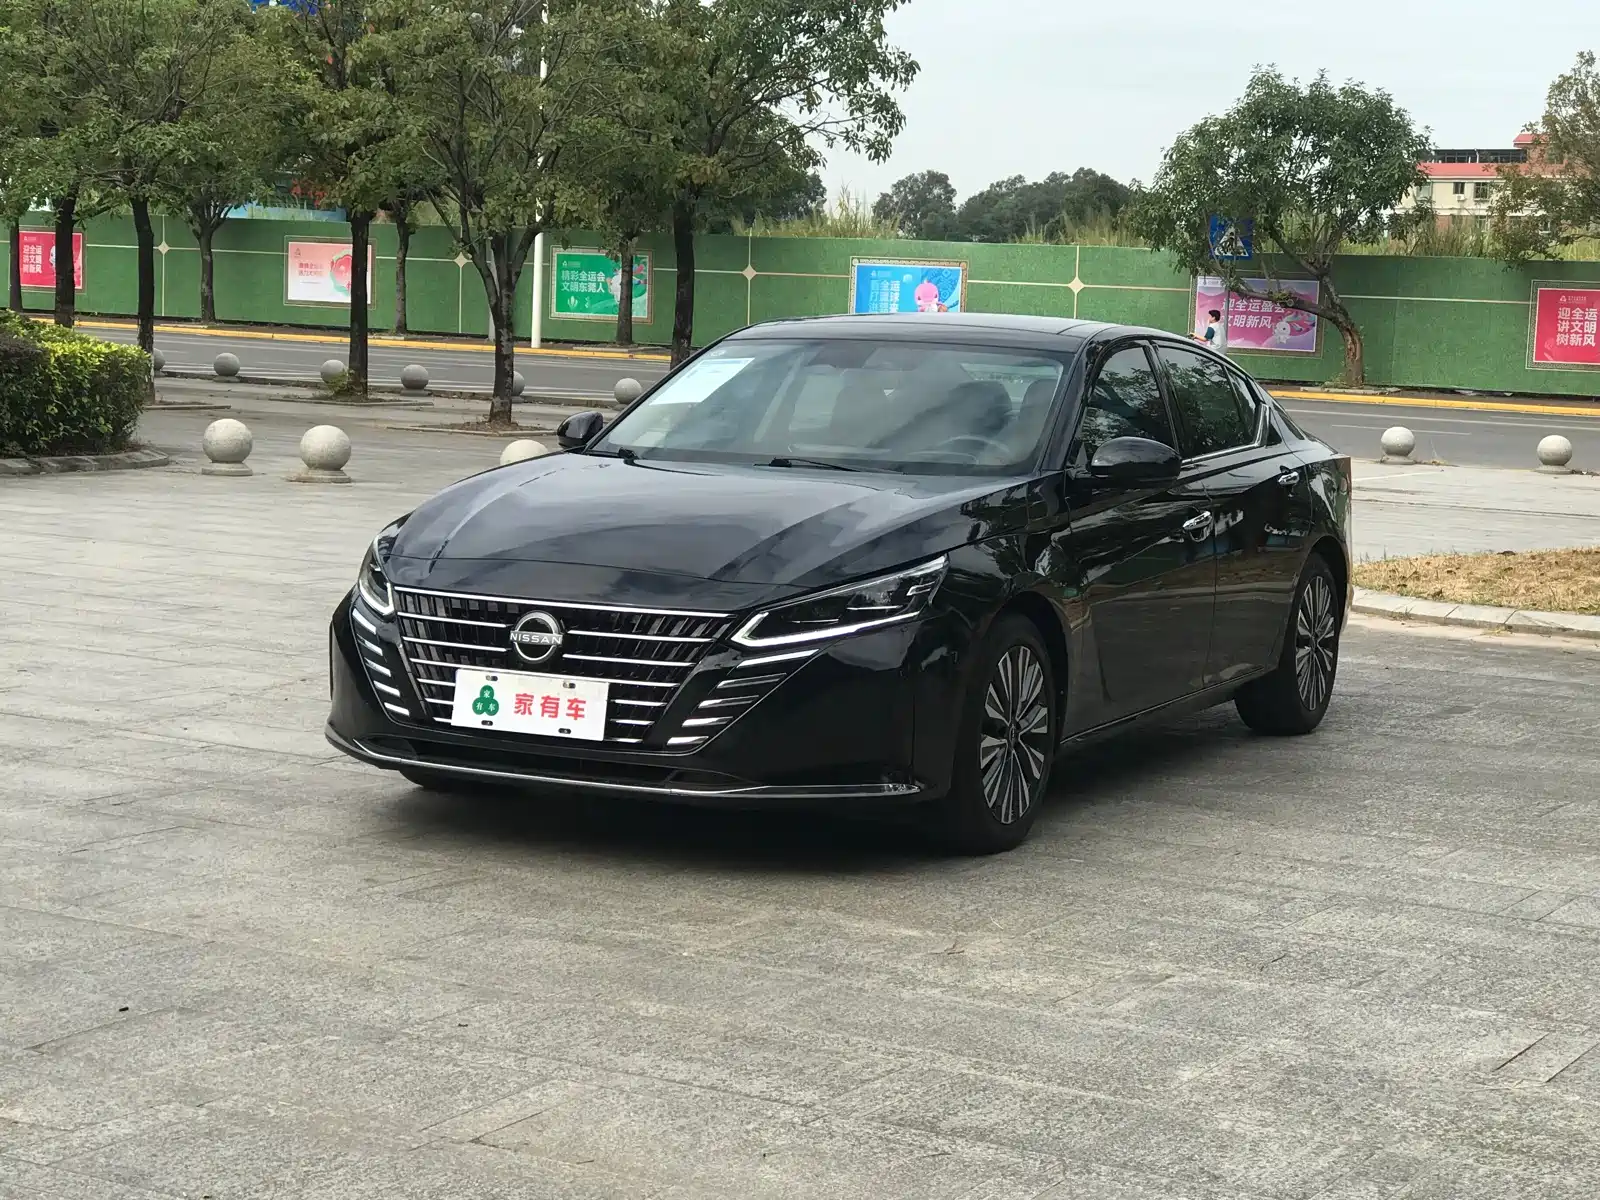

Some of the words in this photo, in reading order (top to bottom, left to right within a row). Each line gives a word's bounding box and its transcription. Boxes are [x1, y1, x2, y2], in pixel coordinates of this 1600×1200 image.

[1557, 307, 1598, 320] 迎全运
[1557, 320, 1597, 333] 讲文明
[1556, 333, 1596, 346] 树新风
[510, 631, 563, 645] NISSAN
[514, 693, 586, 720] 家有车
